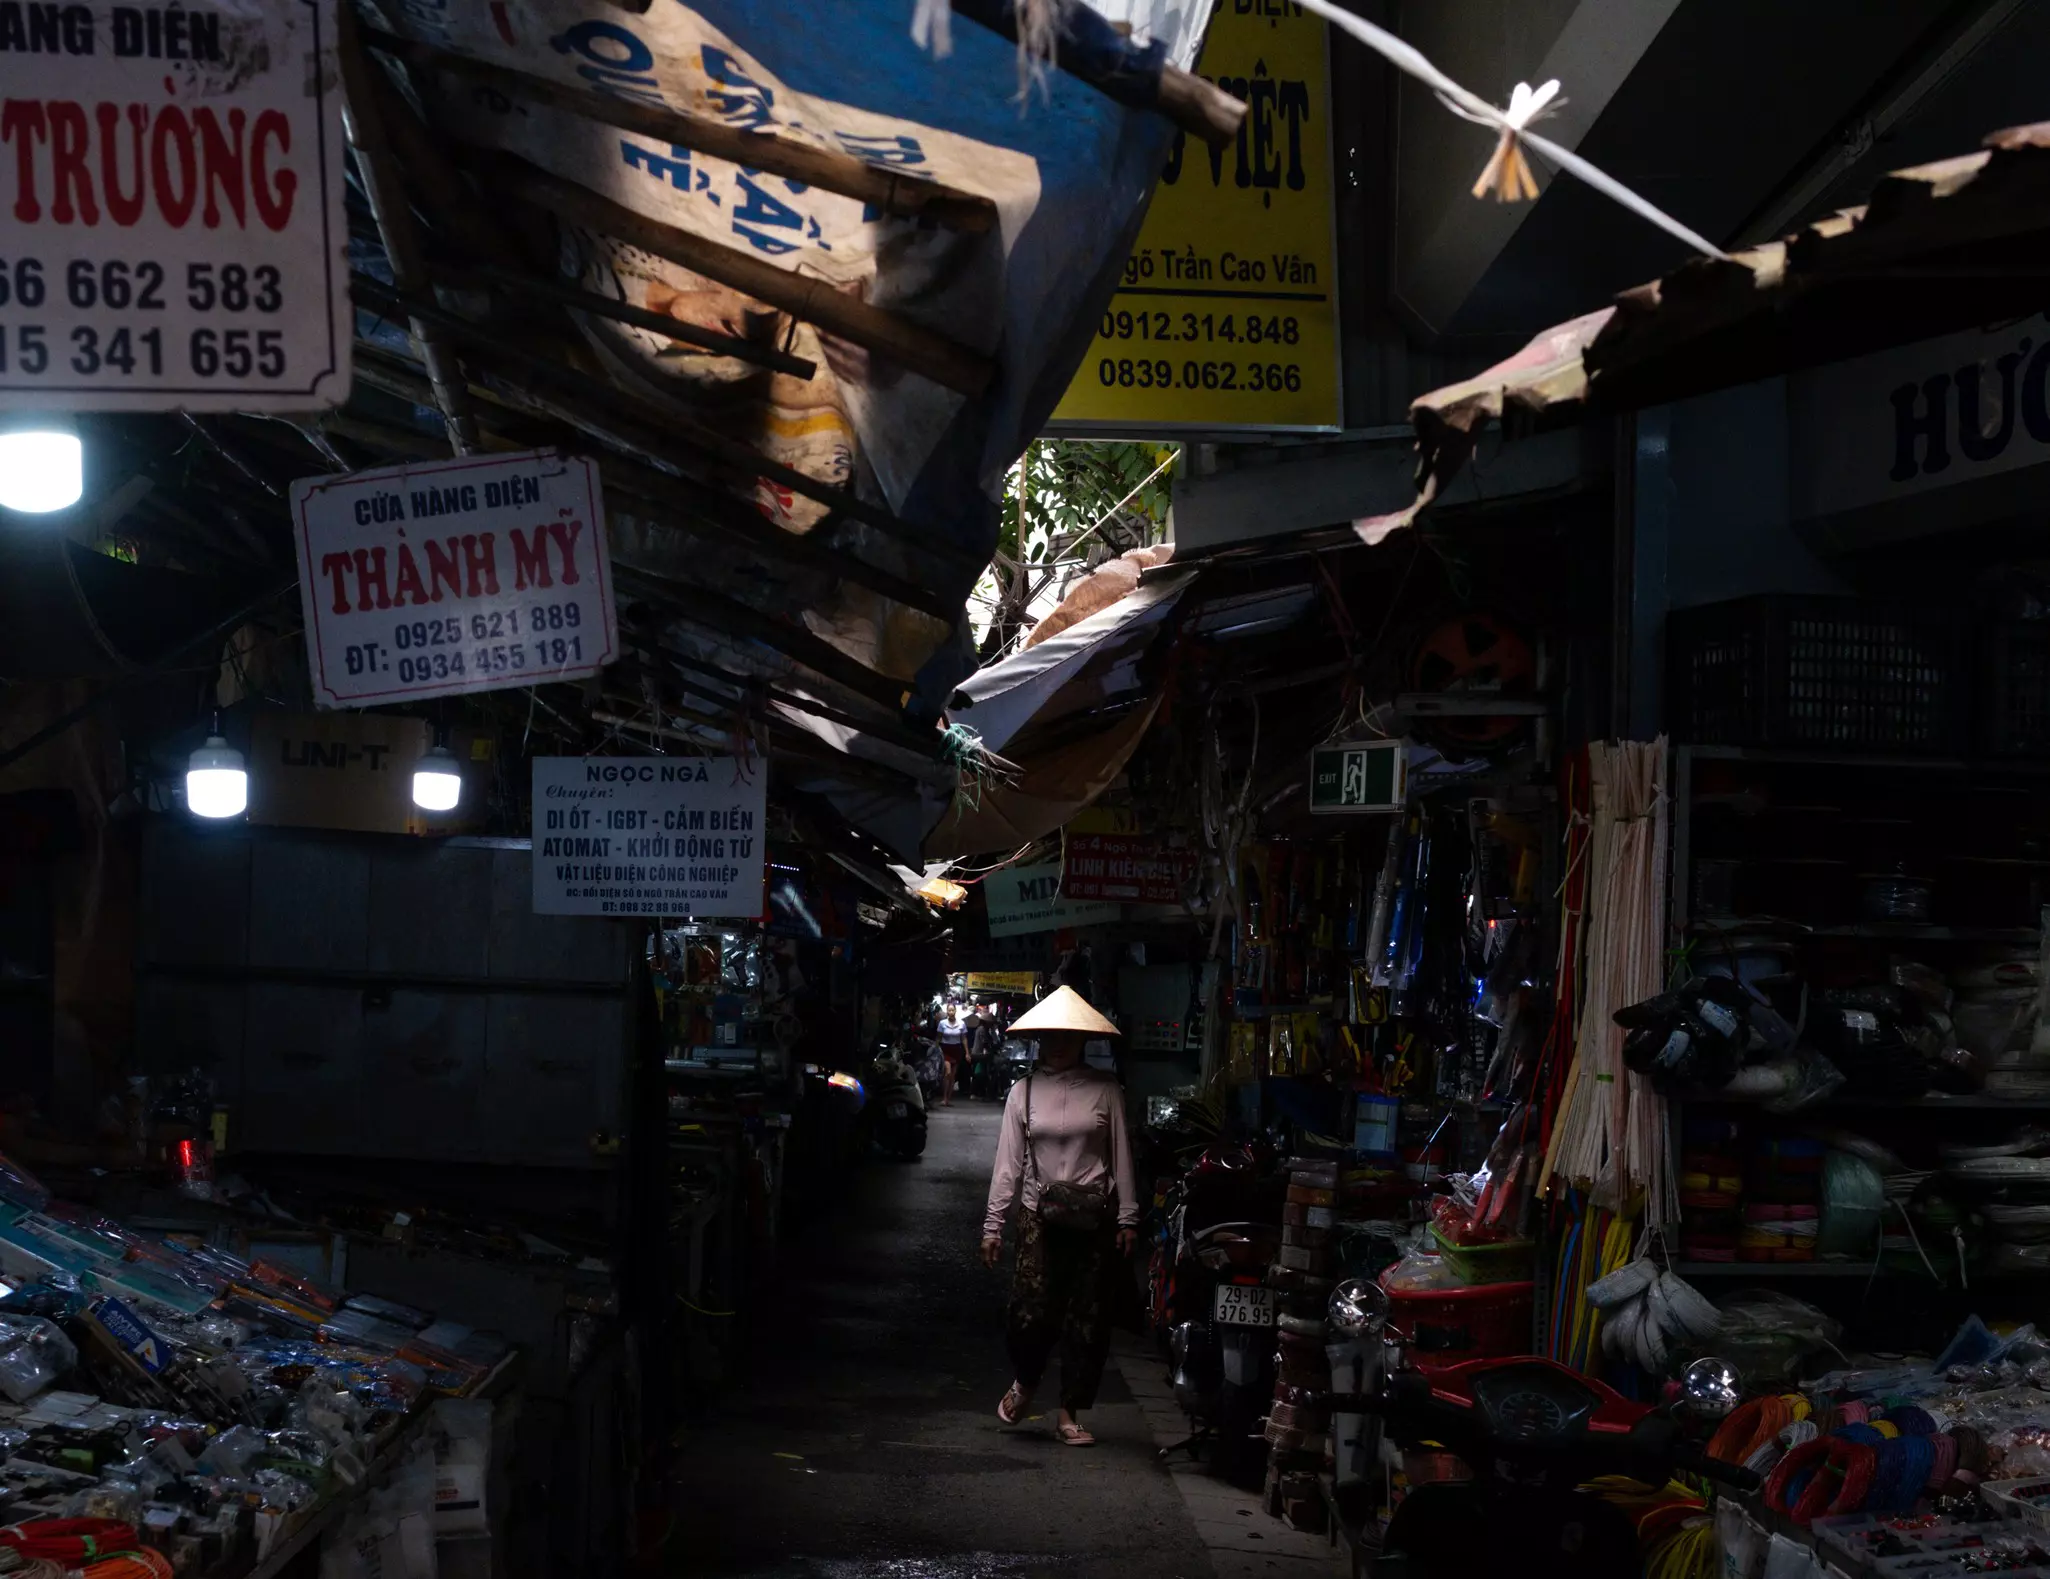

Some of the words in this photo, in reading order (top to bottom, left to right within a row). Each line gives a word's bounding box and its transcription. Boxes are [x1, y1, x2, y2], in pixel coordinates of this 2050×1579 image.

[1160, 243, 1212, 281] Trần
[1219, 251, 1266, 283] Cao
[1272, 253, 1317, 285] Vân
[66, 259, 166, 310] 662
[187, 263, 283, 313] 583
[1099, 308, 1300, 346] 0912.314.848
[69, 325, 163, 376] 341
[190, 328, 286, 378] 655
[1099, 357, 1301, 393] 0839.062.366
[354, 490, 405, 526] CỬA
[411, 482, 478, 519] HÀNG
[483, 474, 541, 512] ĐIỆN
[321, 527, 501, 615] THÀNH
[509, 507, 583, 593] MỸ
[394, 616, 463, 651] 0925
[471, 609, 520, 641] 621
[530, 601, 582, 634] 889
[399, 650, 467, 684] 0934
[474, 643, 526, 674] 455
[535, 635, 583, 667] 181
[281, 738, 390, 771] UNI-T
[586, 765, 655, 788] NGỌC
[660, 761, 710, 783] NGÀ
[1318, 772, 1337, 785] EXIT
[606, 809, 649, 831] IGBT
[663, 803, 706, 831] CẢM
[709, 803, 754, 831] BIẾN
[542, 837, 612, 858] ATOMAT
[1070, 857, 1105, 877] LINH
[1218, 1304, 1272, 1326] 376.95
